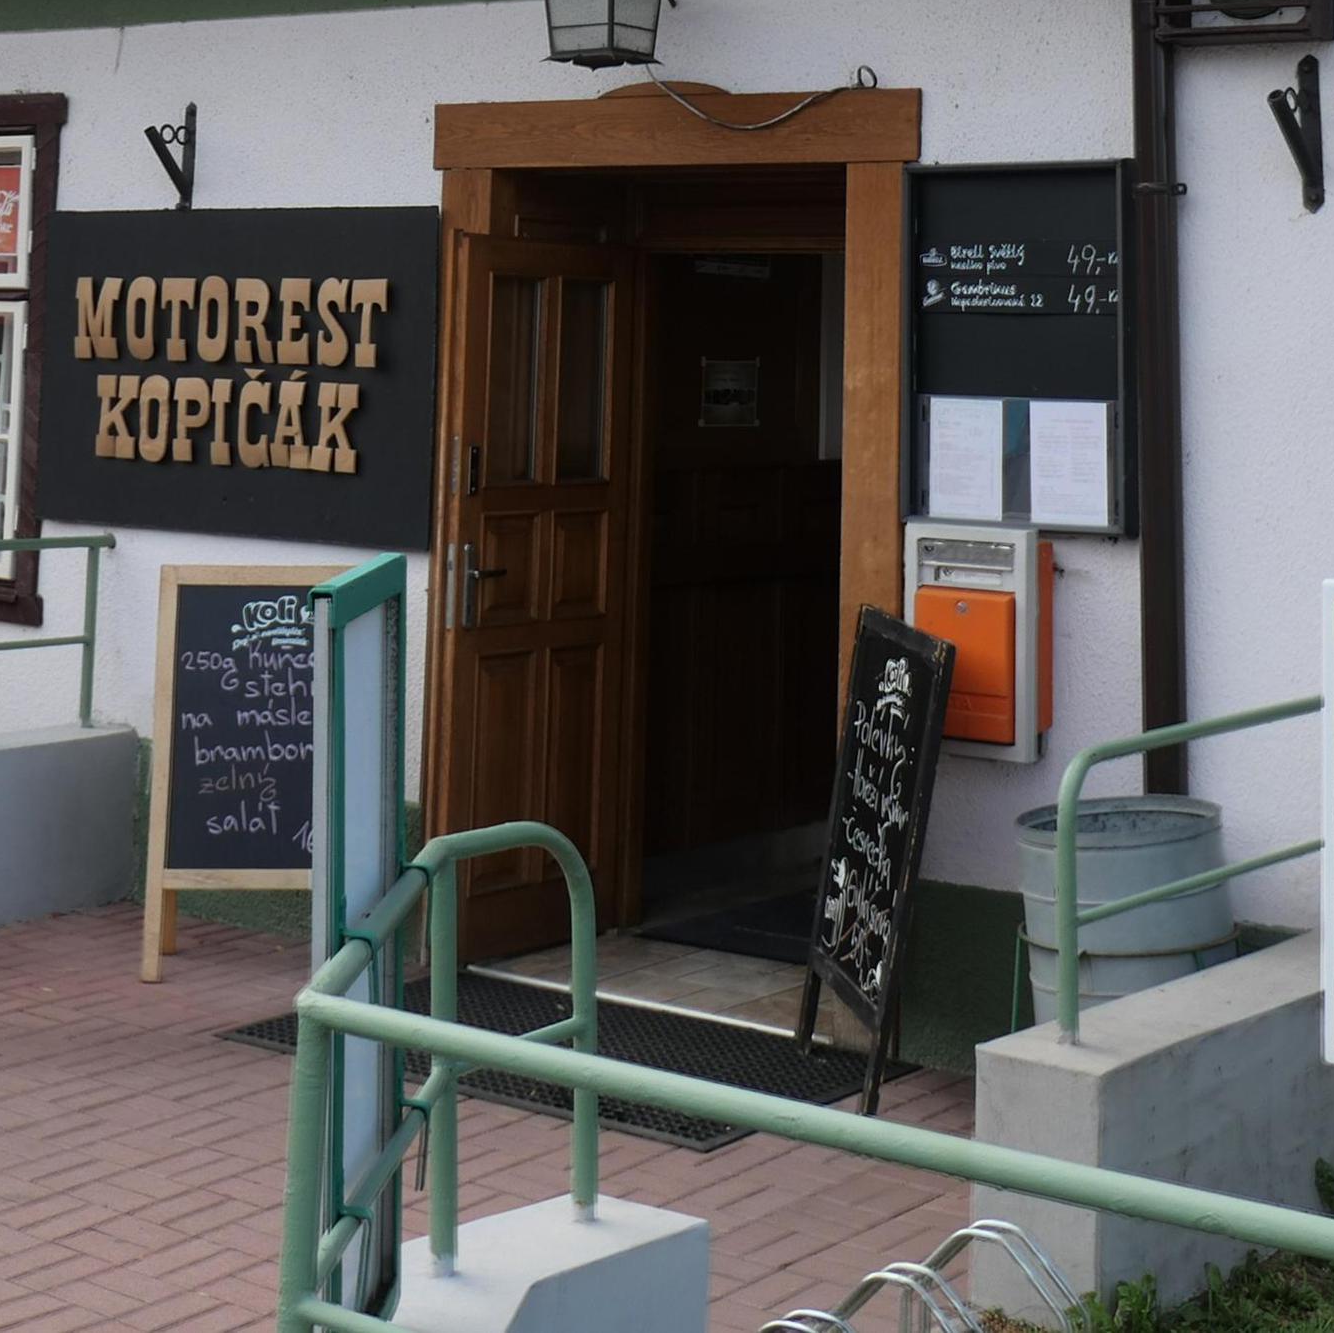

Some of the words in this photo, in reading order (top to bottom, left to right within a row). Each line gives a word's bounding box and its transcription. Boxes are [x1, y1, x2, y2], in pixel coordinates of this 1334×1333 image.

[74, 275, 388, 368] MOTOREST
[95, 368, 359, 474] KOPIČÁK
[181, 650, 239, 691] 250g
[244, 667, 315, 698] steh
[181, 712, 214, 730] na
[198, 763, 277, 803] zelný
[207, 800, 281, 836] salát
